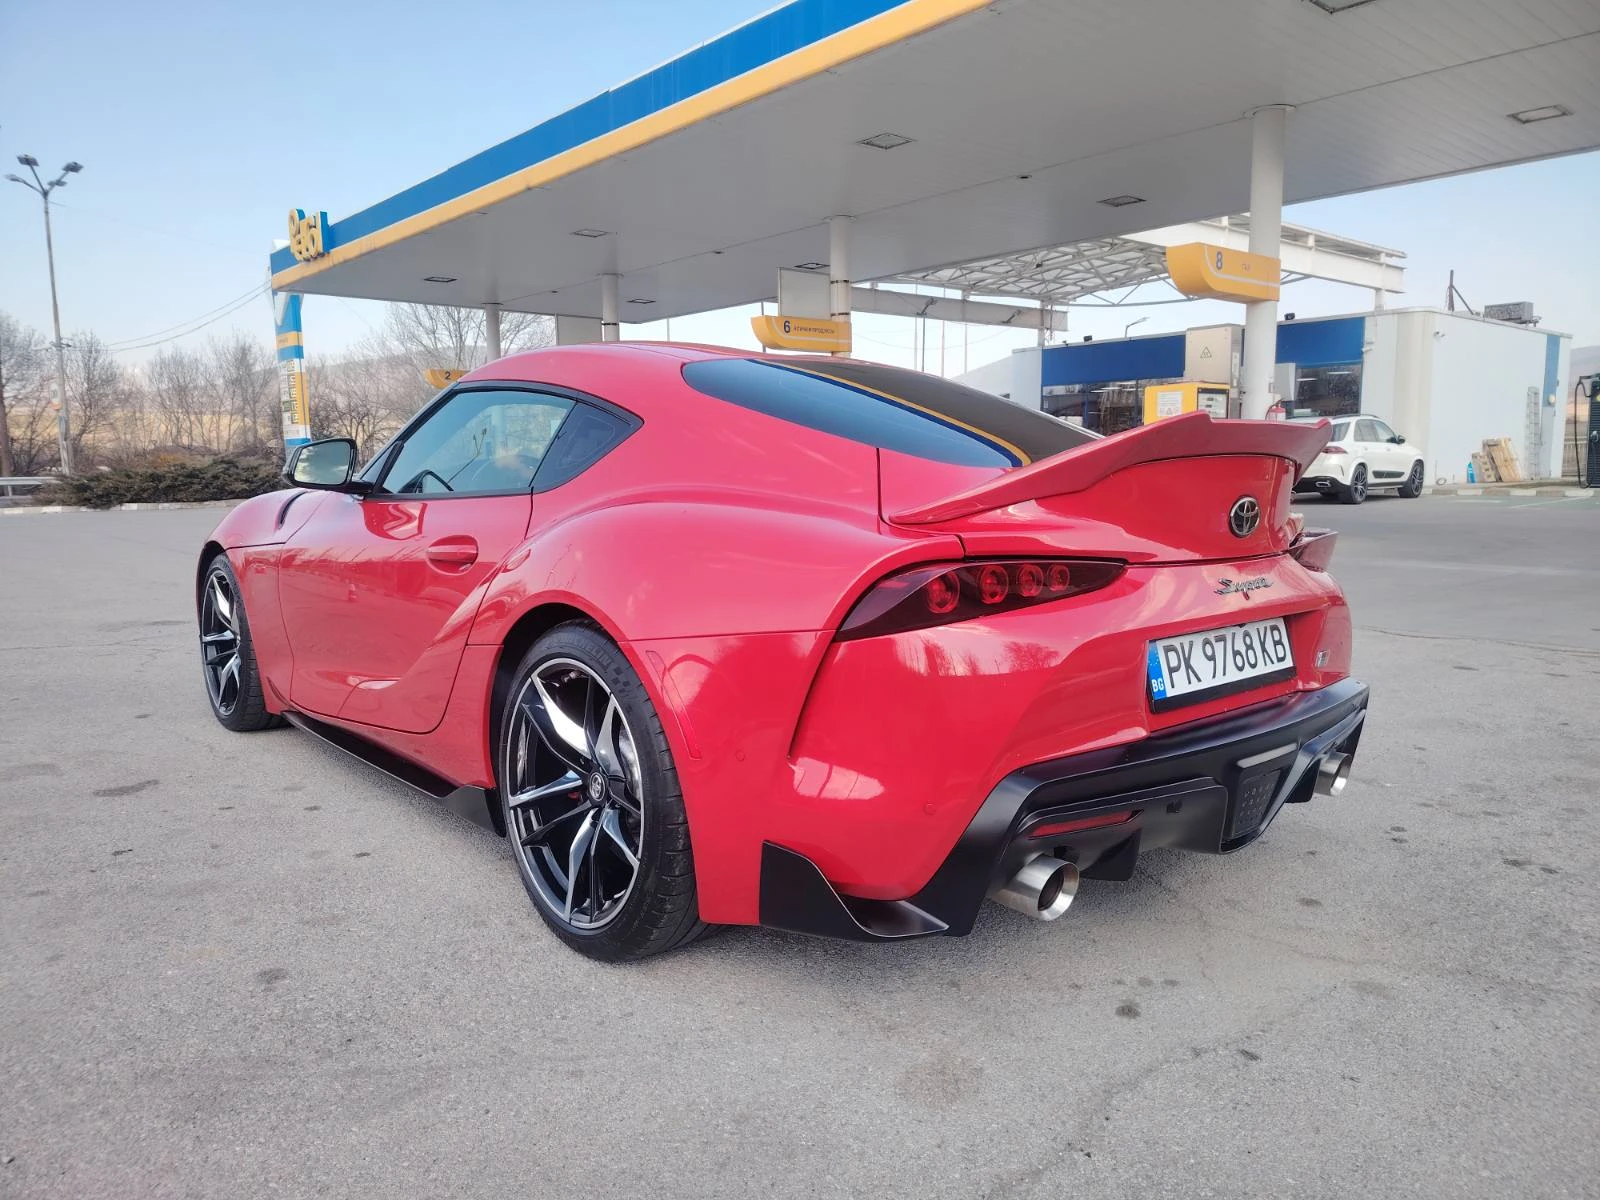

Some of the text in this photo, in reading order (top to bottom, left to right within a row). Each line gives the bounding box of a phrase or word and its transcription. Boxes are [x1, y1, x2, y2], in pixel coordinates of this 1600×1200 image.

[1216, 251, 1223, 270] 8
[783, 320, 791, 334] 6
[444, 371, 452, 380] 2
[1214, 575, 1274, 600] Supra
[1162, 623, 1287, 689] PK 9768 KB
[1151, 677, 1165, 693] BG
